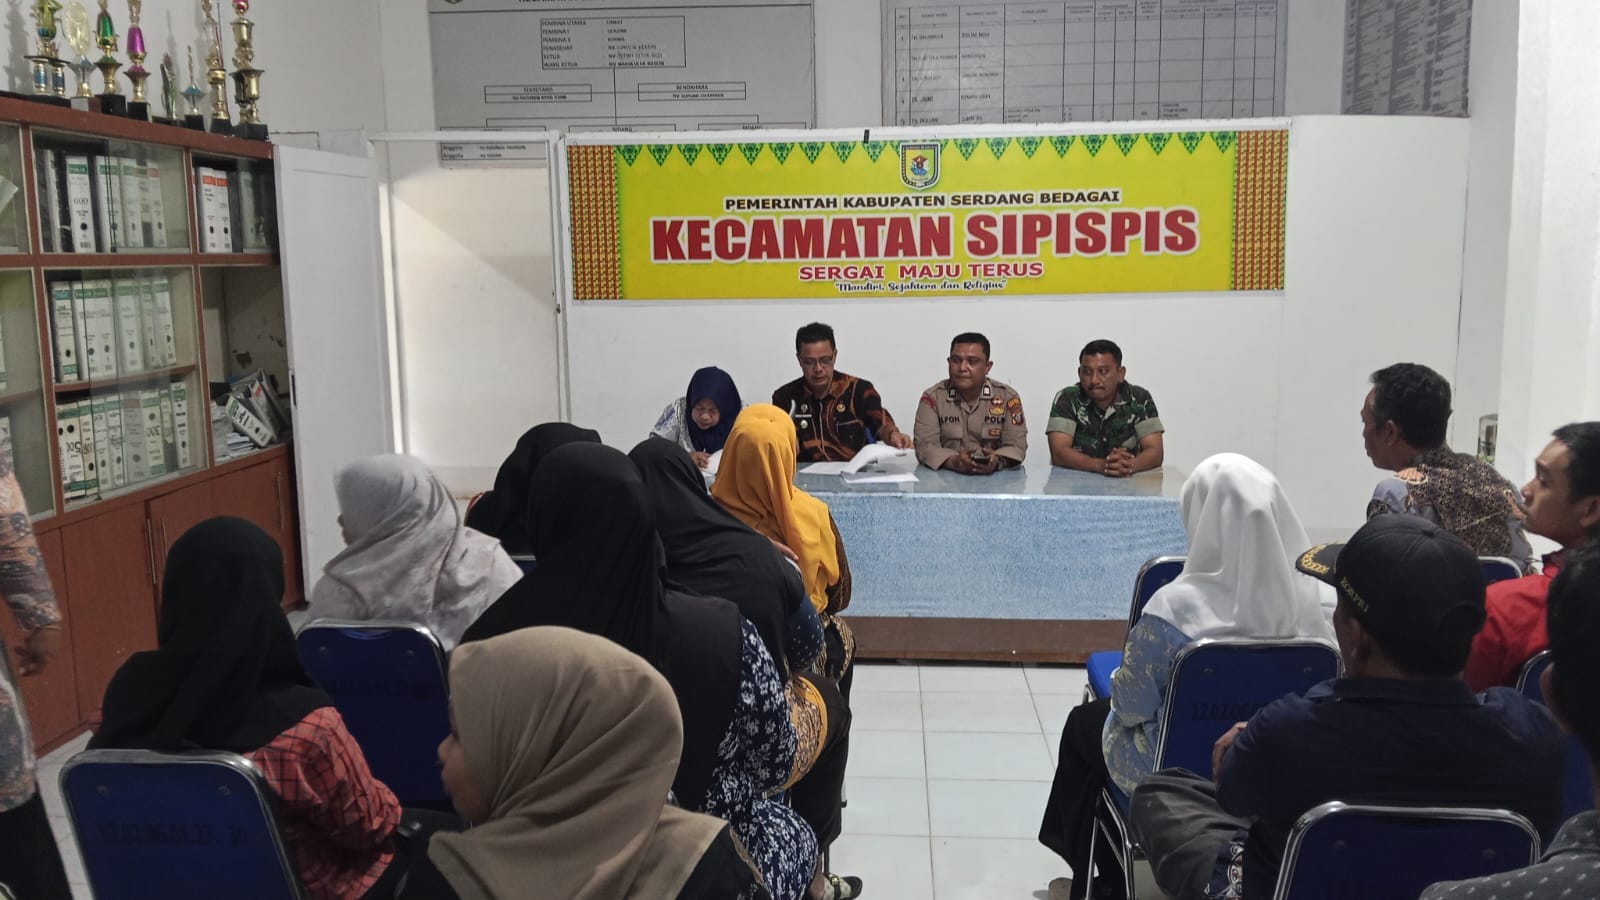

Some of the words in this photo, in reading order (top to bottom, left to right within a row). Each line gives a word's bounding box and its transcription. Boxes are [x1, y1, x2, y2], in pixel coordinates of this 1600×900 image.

[725, 198, 837, 210] PEMERINTAH
[843, 195, 945, 209] KABUPATEN
[951, 193, 1034, 206] SERDANG
[1040, 190, 1120, 204] BEDAGAI
[652, 216, 950, 261] KECAMATAN
[967, 209, 1197, 256] SIPISPIS
[800, 265, 885, 280] SERGAI
[899, 264, 961, 279] MAJU
[968, 262, 1043, 277] TERUS
[888, 281, 938, 292] Sejahtera
[941, 280, 960, 289] dan
